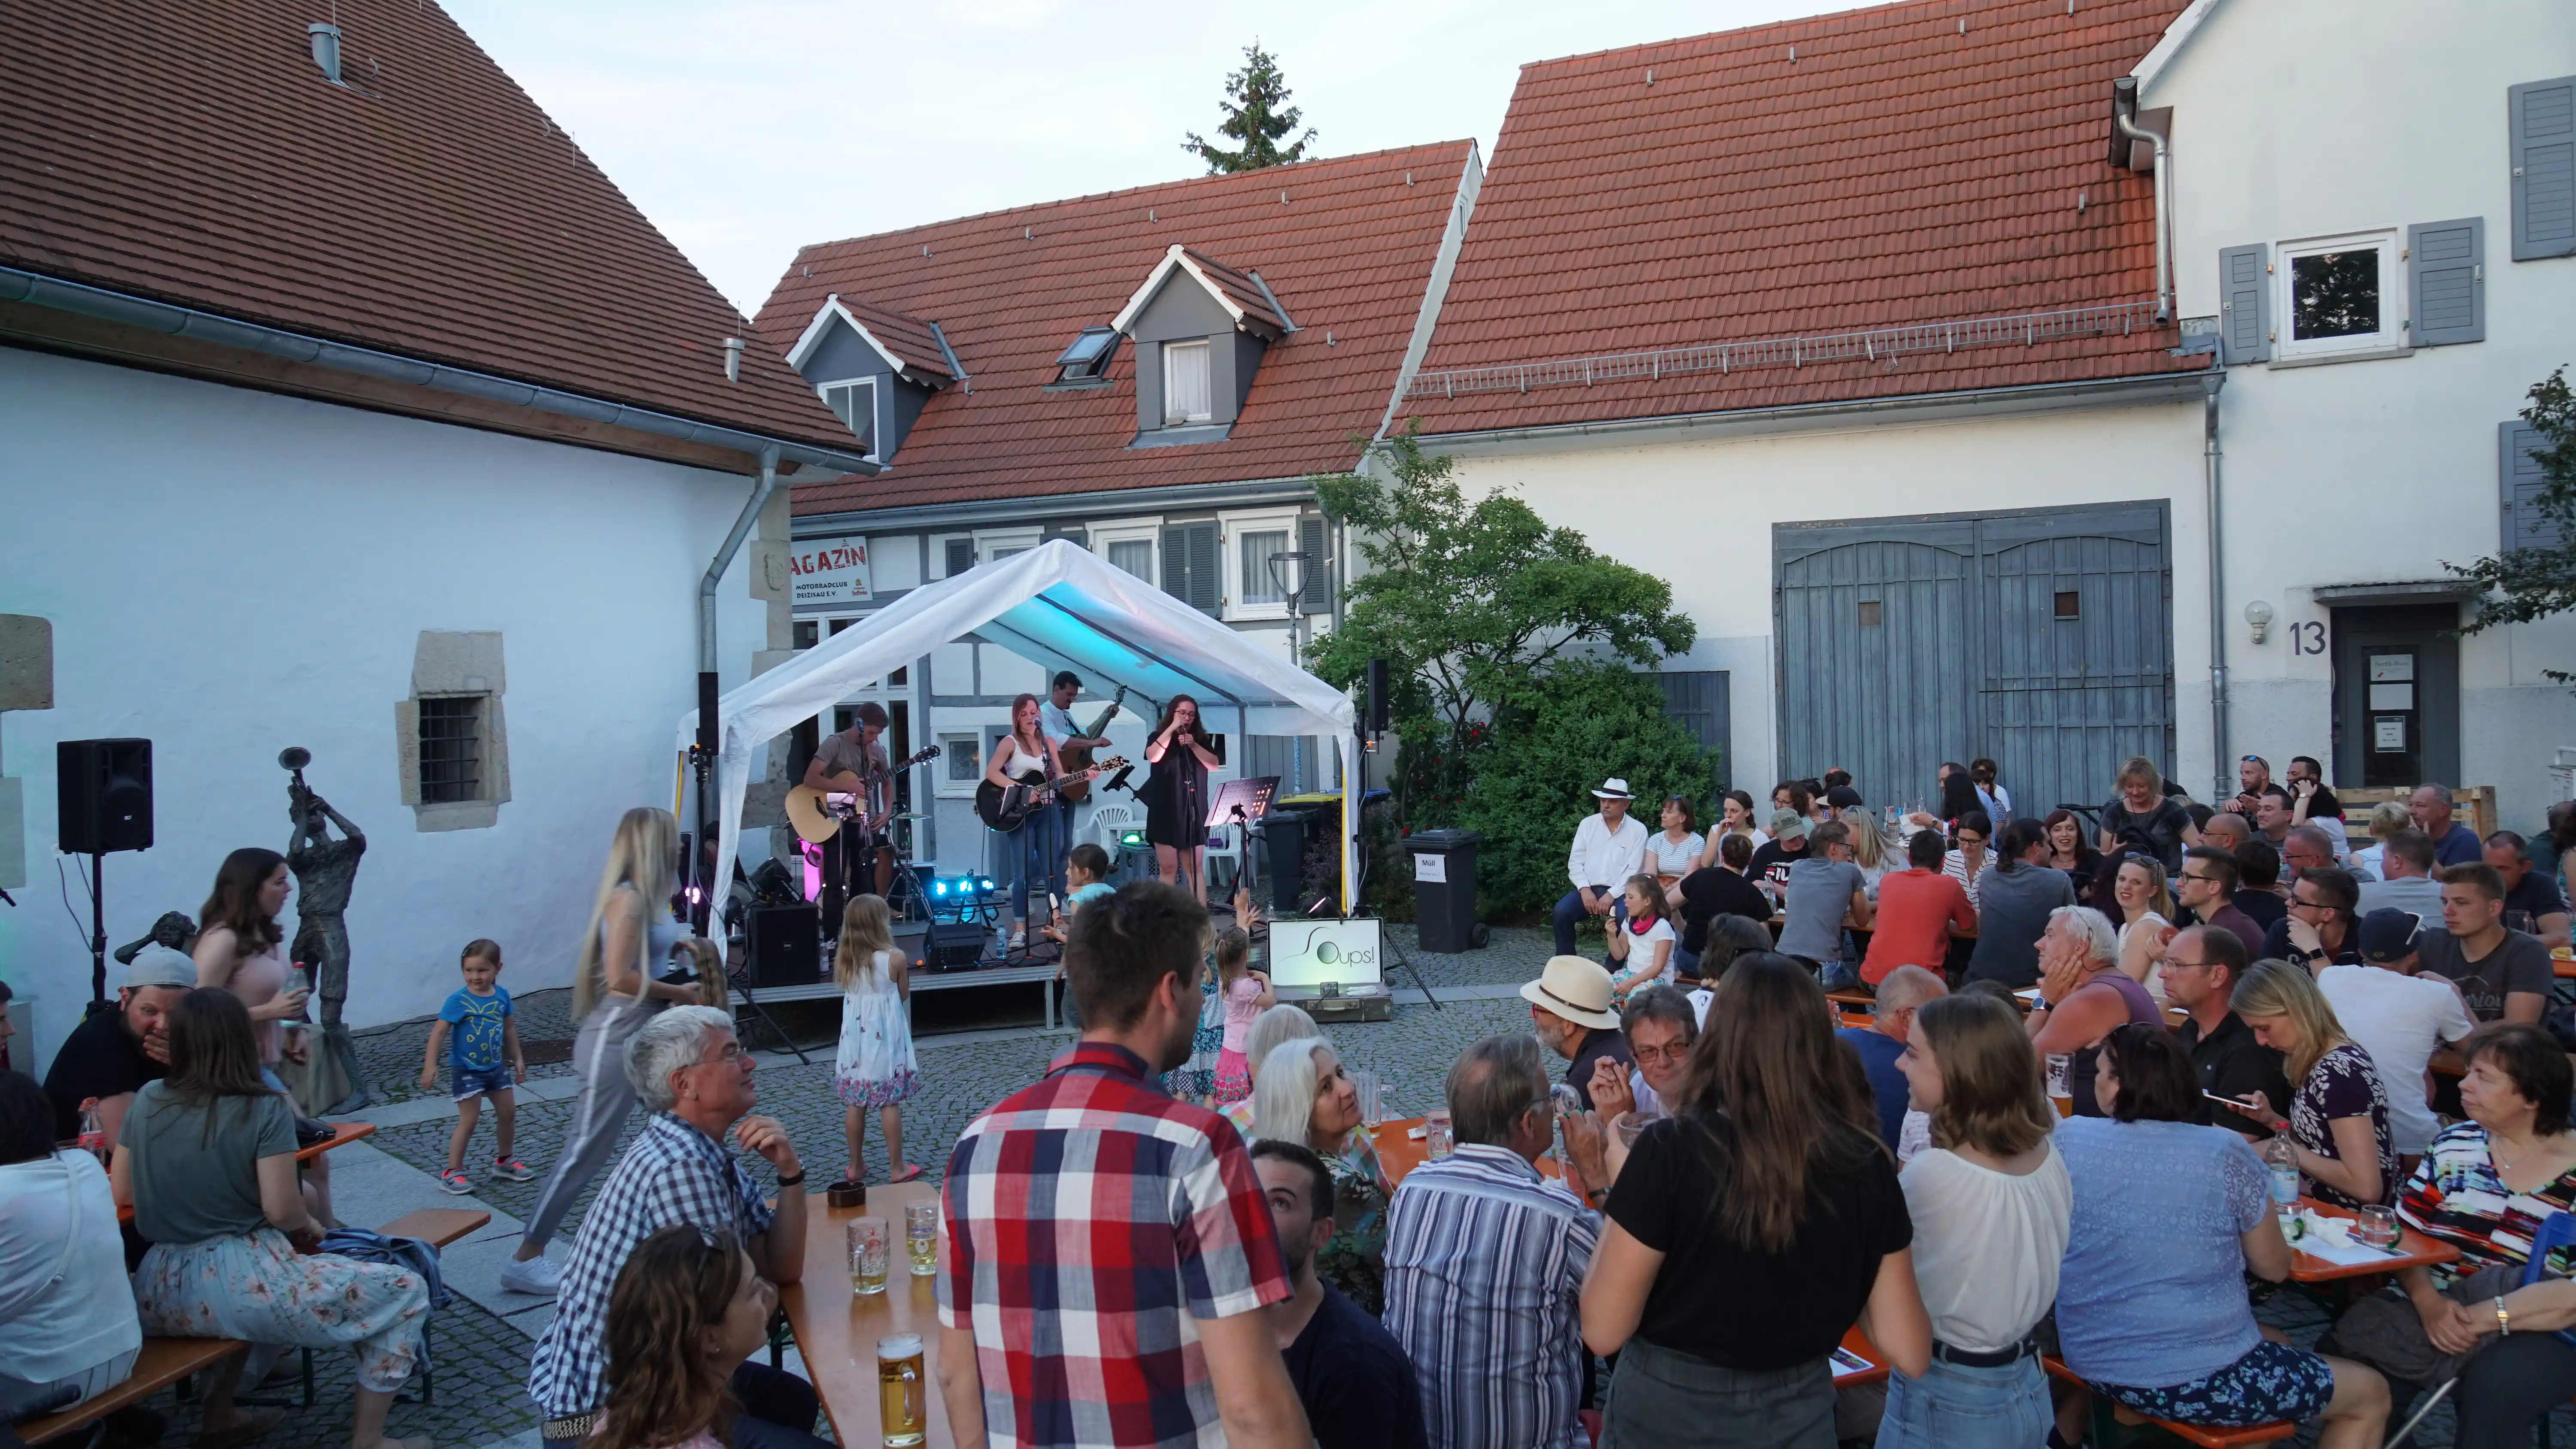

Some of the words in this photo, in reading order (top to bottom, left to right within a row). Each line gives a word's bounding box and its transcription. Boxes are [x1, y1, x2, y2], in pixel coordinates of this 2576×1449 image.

[791, 546, 866, 575] AGAZIN
[796, 581, 848, 590] MOTORRADCLUB
[2289, 621, 2326, 655] 13
[1317, 941, 1374, 967] Oups!
